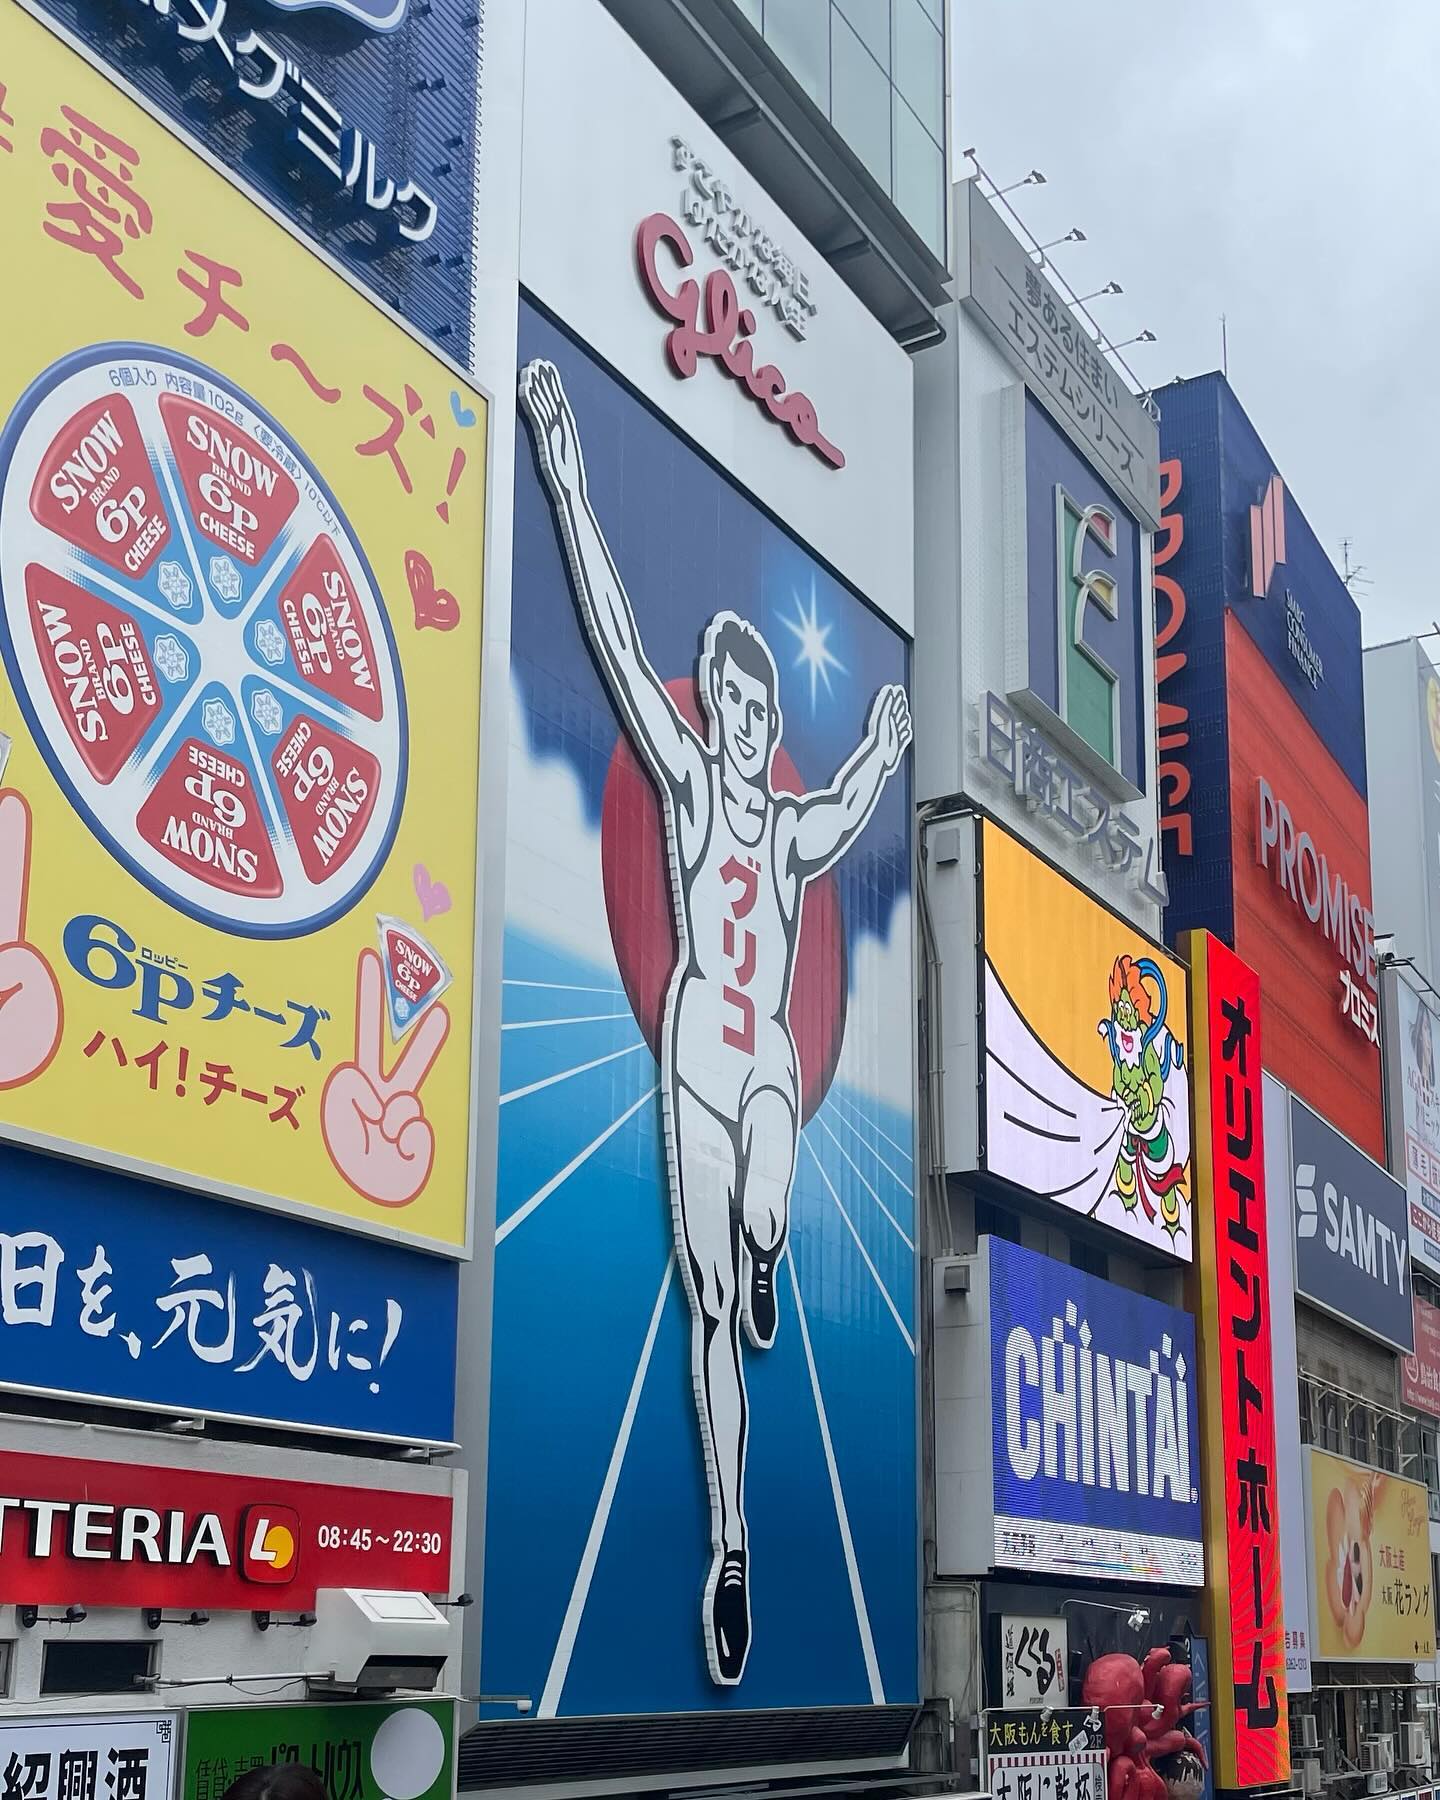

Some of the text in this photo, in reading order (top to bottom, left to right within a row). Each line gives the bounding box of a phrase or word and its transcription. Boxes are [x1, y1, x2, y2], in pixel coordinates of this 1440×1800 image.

[140, 0, 437, 241] メグミルク
[634, 212, 846, 470] Glico
[108, 367, 158, 387] 6個入り
[1007, 300, 1134, 484] エステムシリーズ
[50, 410, 124, 514] SNOW
[89, 466, 121, 507] BRAND
[186, 415, 279, 498] SNOW
[212, 462, 252, 497] BRAND
[96, 486, 147, 543] 6P
[198, 472, 259, 535] 6P
[199, 513, 256, 560] CHEESE
[124, 514, 167, 572] CHEESE
[119, 622, 157, 705] CHEESE
[283, 599, 314, 675] CHEESE
[302, 593, 333, 674] 6P
[322, 571, 375, 692] SNOW
[324, 606, 345, 660] BRAND
[37, 599, 109, 742] SNOW
[80, 638, 107, 700] BRAND
[96, 622, 135, 715] 6P
[188, 745, 246, 788] CHEESE
[276, 722, 312, 778] CHEESE
[293, 746, 335, 802] 6P
[184, 770, 247, 828] 6P
[192, 811, 234, 840] BRAND
[313, 767, 369, 866] SNOW
[315, 776, 340, 816] BRAND
[160, 815, 258, 884] SNOW
[1255, 776, 1378, 994] PROMISE
[142, 947, 189, 970] ロッピー
[395, 939, 433, 976] SNOW
[397, 963, 421, 992] 6P
[719, 854, 762, 1057] グリコ
[1339, 969, 1380, 1049] プロミス
[1323, 1181, 1407, 1296] SAMTY
[1221, 996, 1279, 1729] オリエントホーム
[1005, 1300, 1192, 1503] CHINTAI
[1014, 1626, 1056, 1696] くくる
[989, 1720, 1074, 1747] 大阪もんを食す
